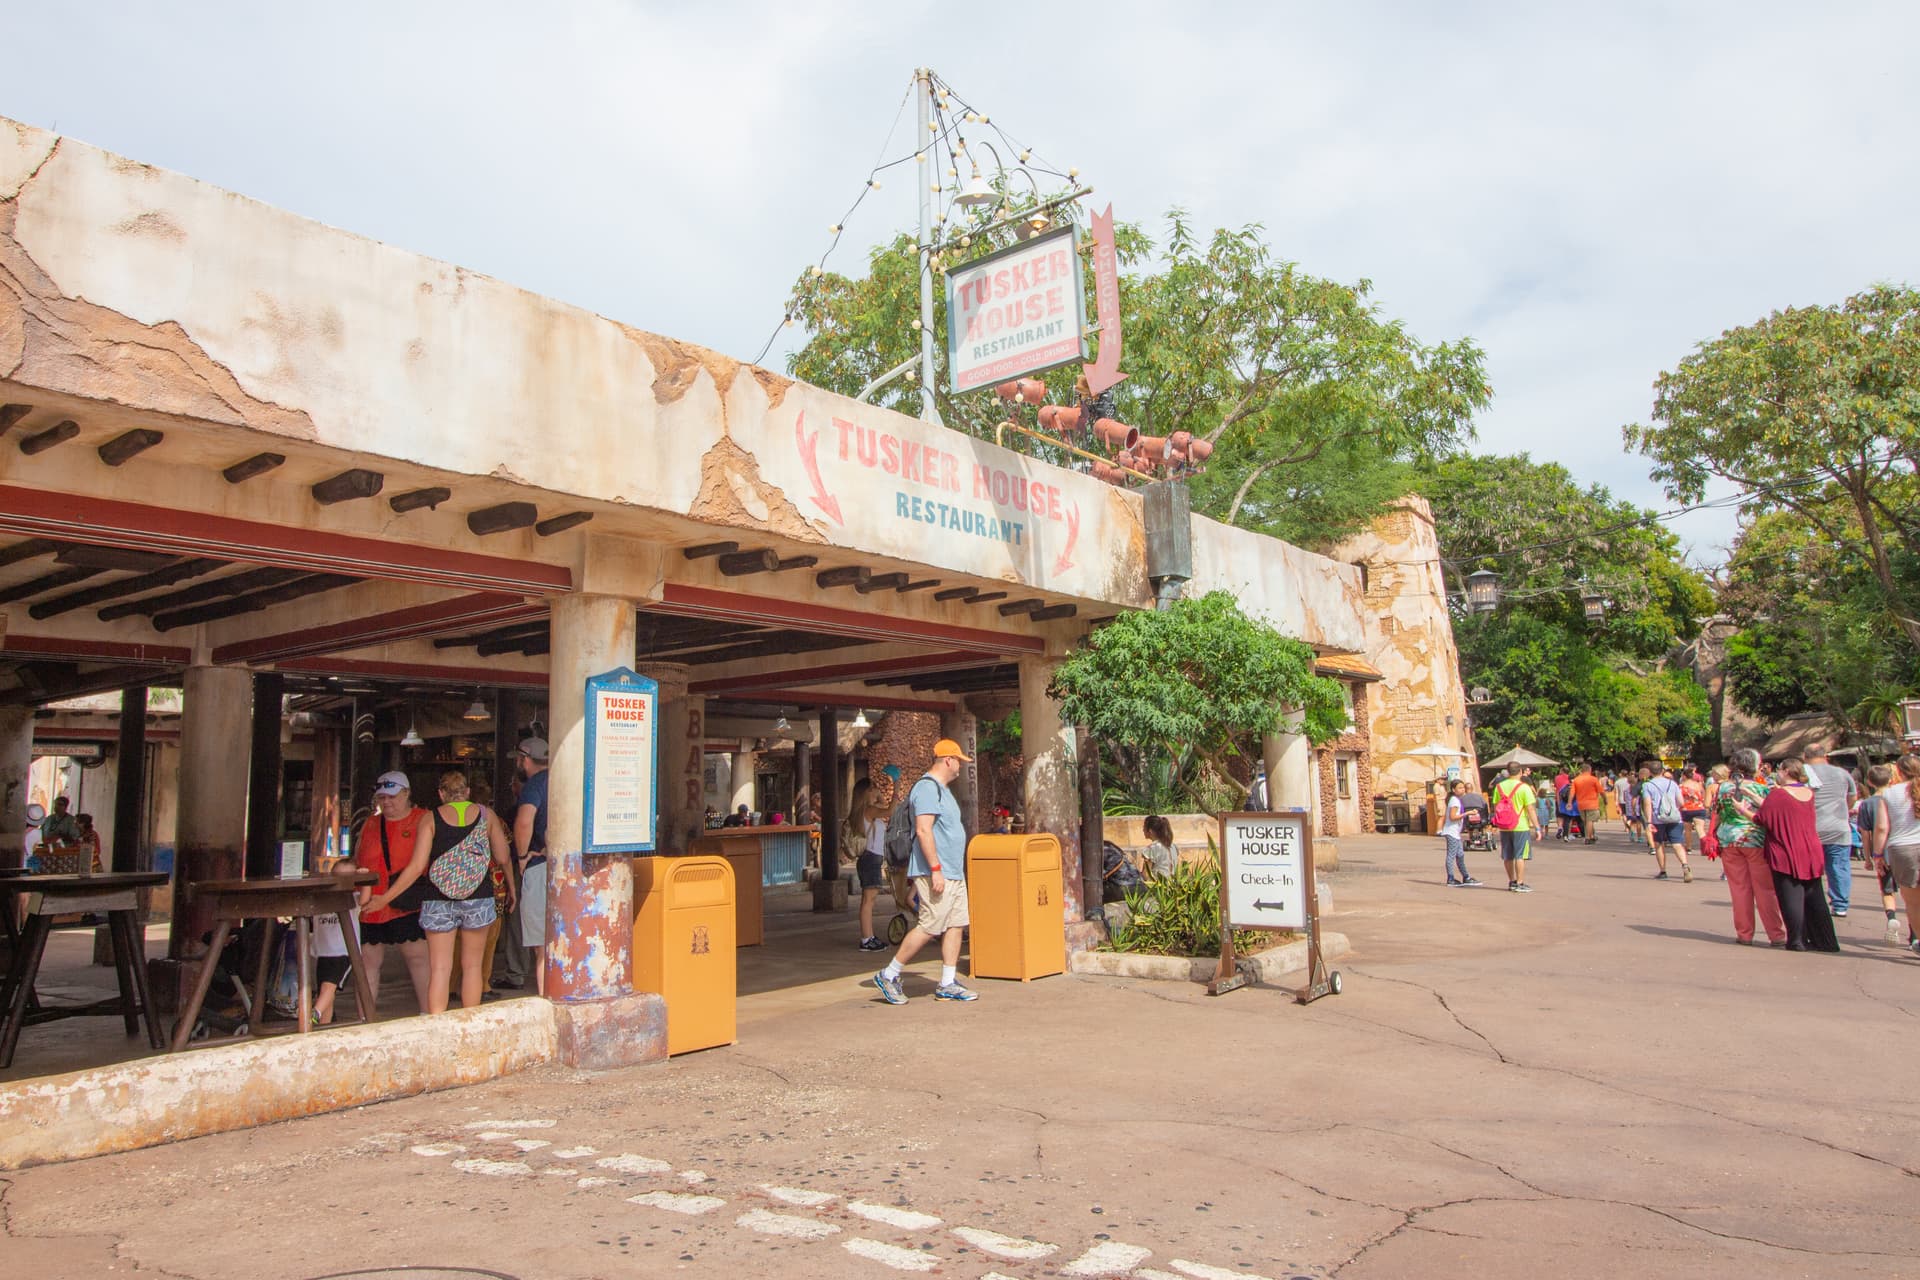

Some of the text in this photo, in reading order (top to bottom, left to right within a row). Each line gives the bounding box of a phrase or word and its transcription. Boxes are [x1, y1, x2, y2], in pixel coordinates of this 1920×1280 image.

[957, 249, 1070, 312] TUSKER
[1099, 244, 1117, 345] CHECK IN
[966, 286, 1065, 342] HOUSE
[973, 319, 1065, 360] RESTAURANT
[832, 416, 1063, 522] TUSKER HOUSE
[896, 491, 1024, 545] RESTAURANT
[603, 697, 646, 710] TUSKER
[606, 709, 644, 721] HOUSE
[684, 709, 701, 810] BAR
[1236, 826, 1295, 839] TUSKER
[1241, 843, 1290, 856] HOUSE
[1240, 873, 1294, 886] Check-In
